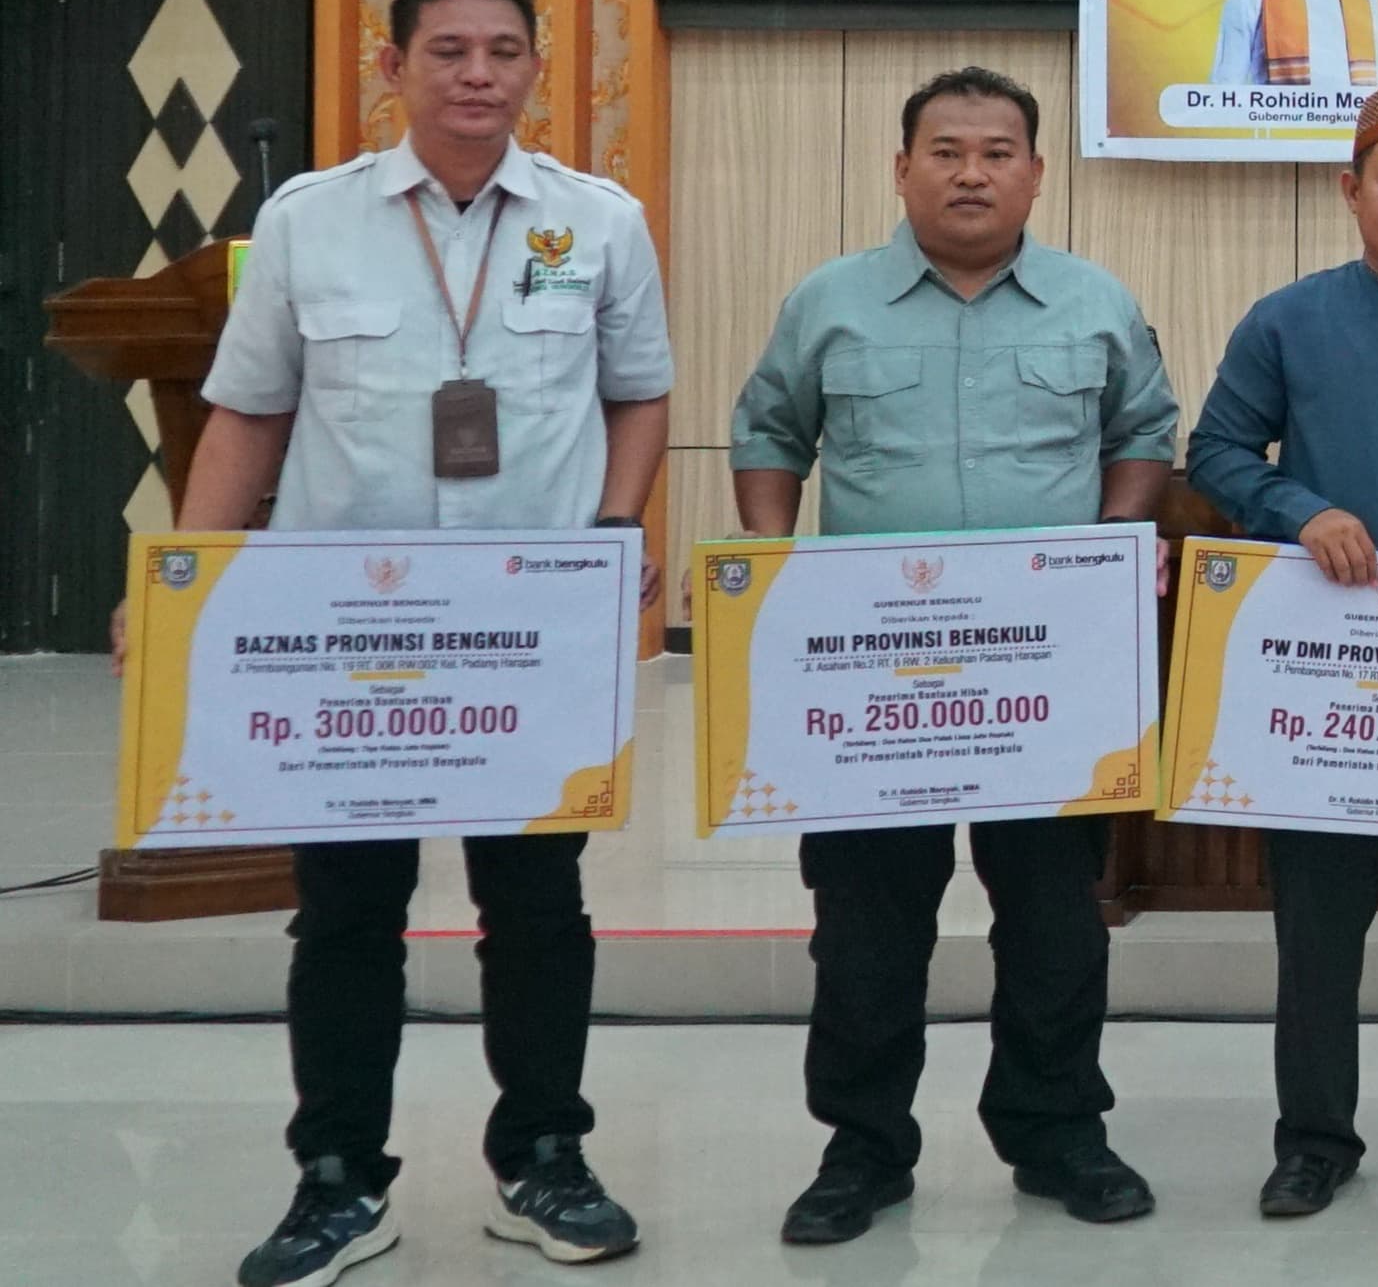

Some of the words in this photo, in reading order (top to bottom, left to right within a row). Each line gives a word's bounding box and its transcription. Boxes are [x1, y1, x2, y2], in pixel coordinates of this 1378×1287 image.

[1187, 91, 1214, 108] Dr.
[1222, 91, 1242, 108] H.
[1250, 91, 1328, 108] Rohidin
[1249, 111, 1304, 122] Gubernur
[234, 633, 317, 655] BAZNAS
[325, 632, 424, 654] PROVINSI
[433, 630, 539, 652] BENGKULU
[807, 635, 845, 654] MUI
[852, 630, 942, 653] PROVINSI
[949, 624, 1047, 647] BENGKULU
[1261, 638, 1291, 658] PW
[1297, 641, 1332, 660] DMI
[247, 709, 303, 747] Rp.
[313, 704, 518, 739] 300.000.000
[805, 705, 855, 741] Rp.
[864, 694, 1049, 732] 250.000.000
[1267, 707, 1316, 743] Rp.
[834, 752, 858, 764] Dari
[1291, 755, 1314, 766] Dari
